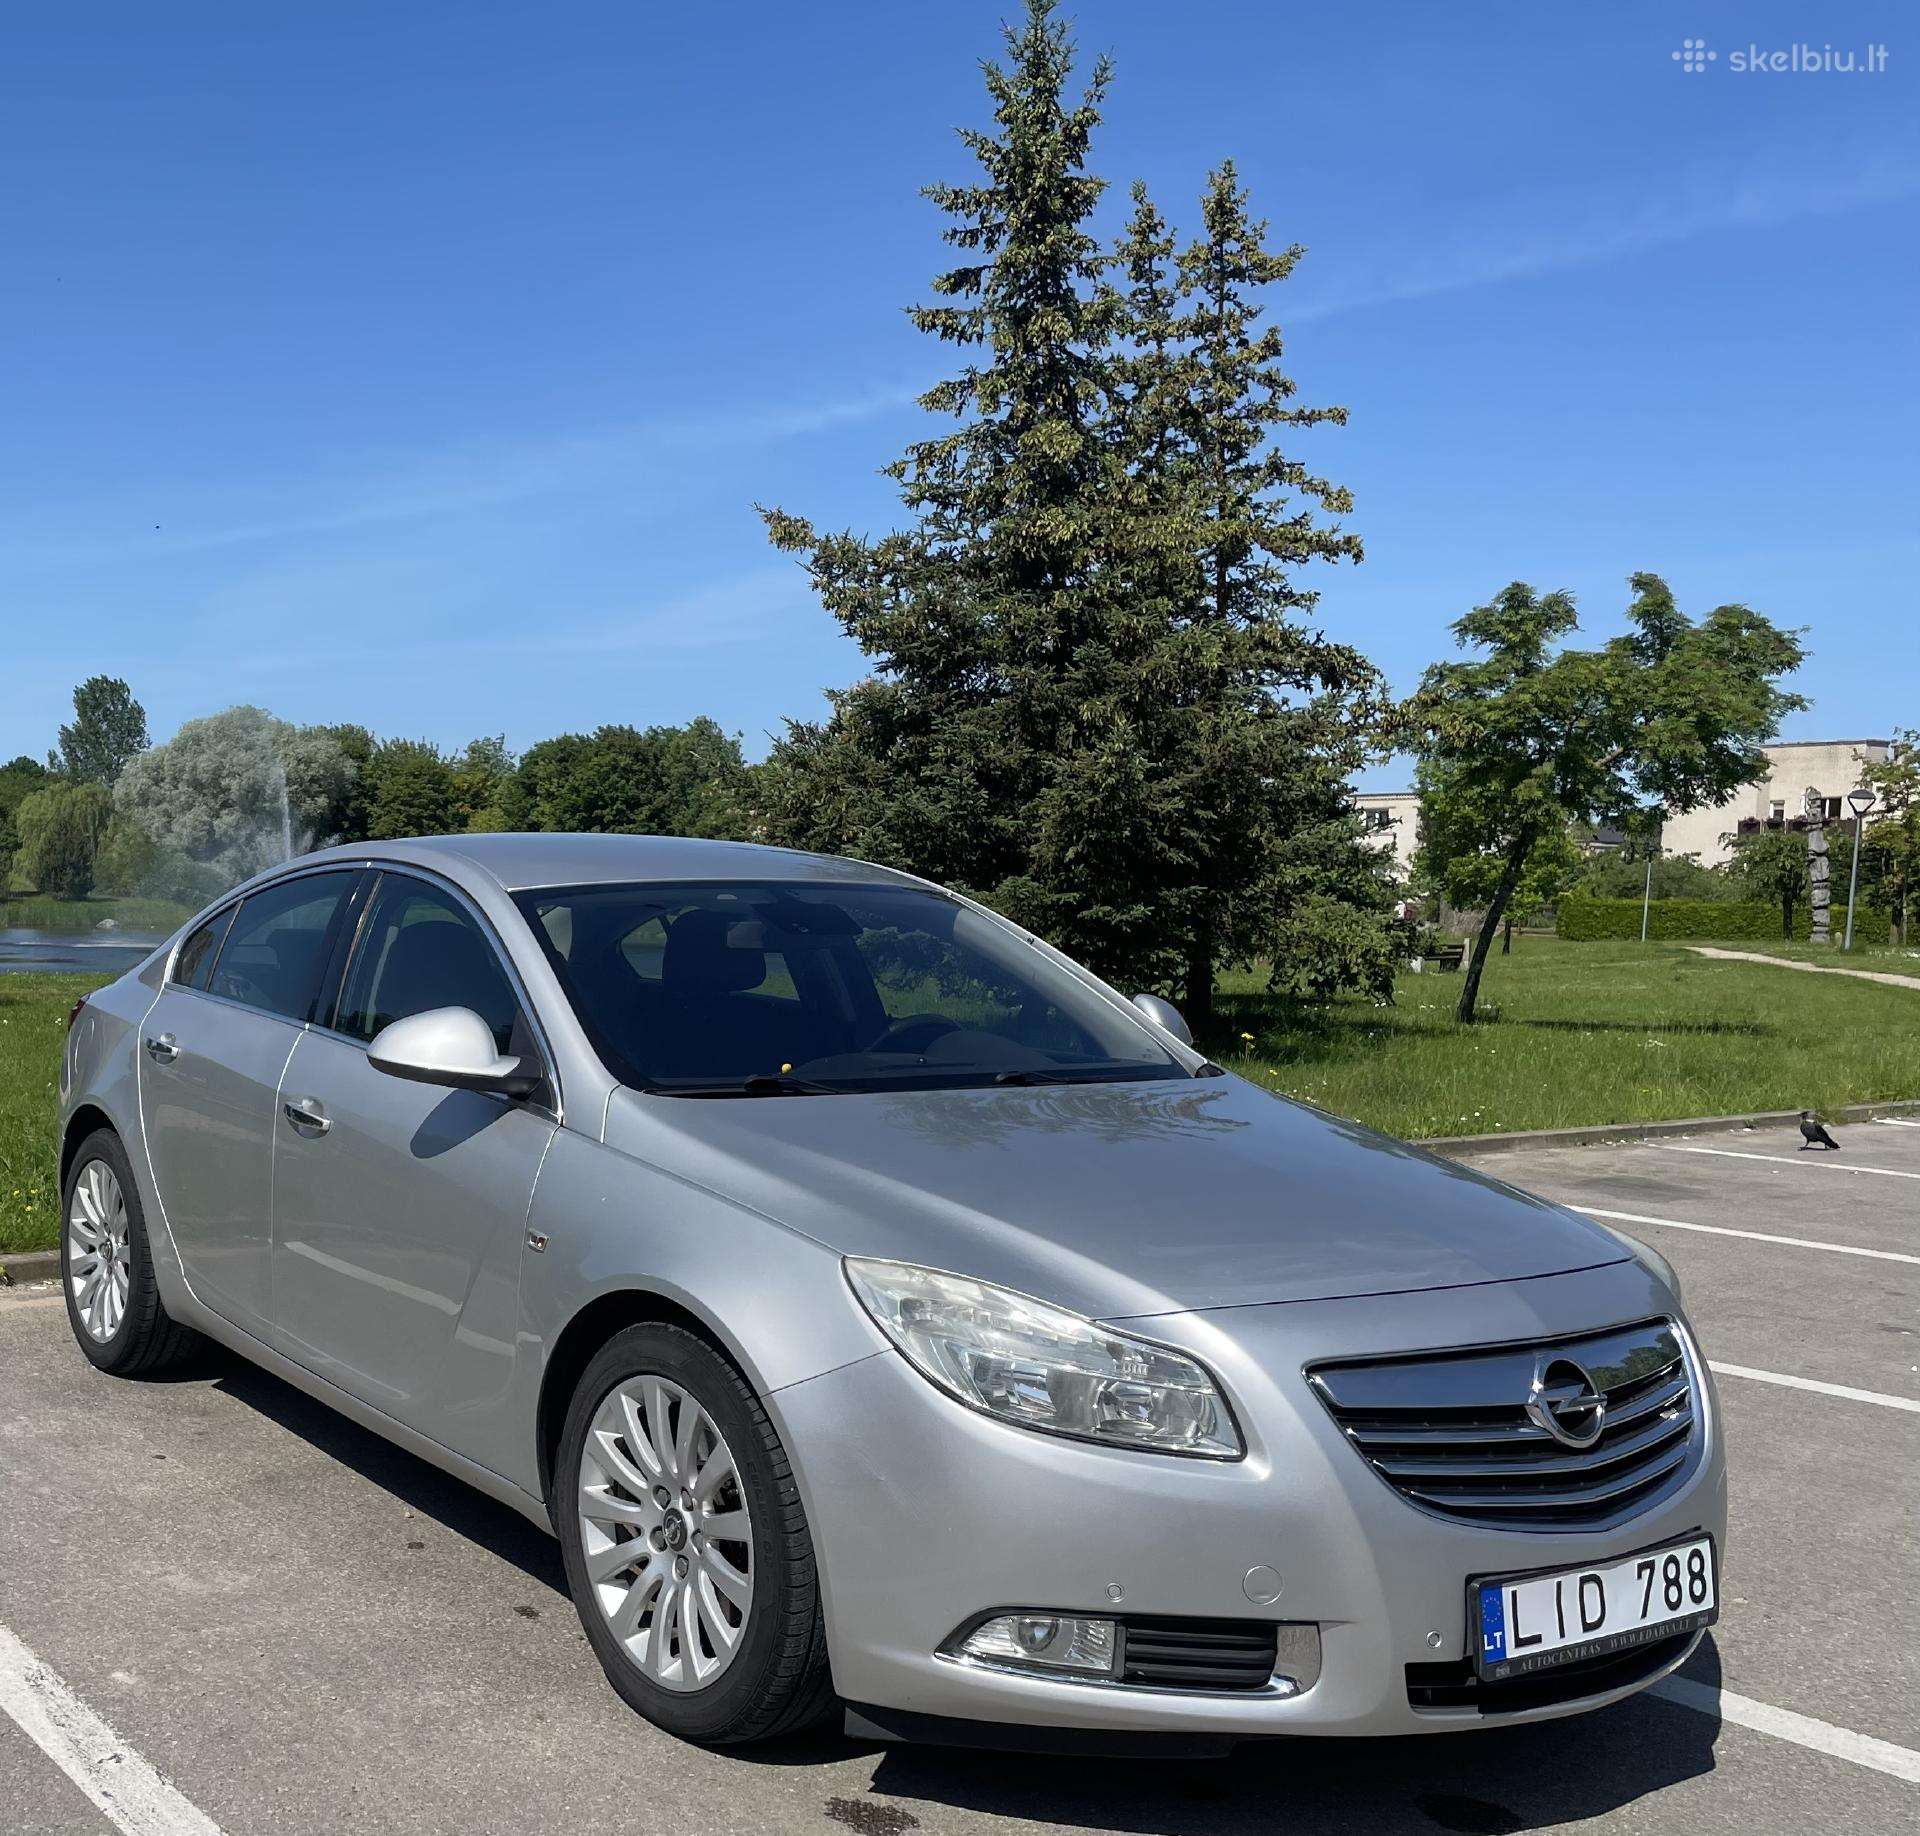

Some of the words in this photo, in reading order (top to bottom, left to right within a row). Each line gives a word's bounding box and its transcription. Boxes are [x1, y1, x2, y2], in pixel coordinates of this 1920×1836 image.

[1511, 1573, 1606, 1648] LID
[1637, 1548, 1707, 1620] 788
[1483, 1631, 1502, 1651] LT
[1519, 1643, 1601, 1672] AUTOCENTRAS
